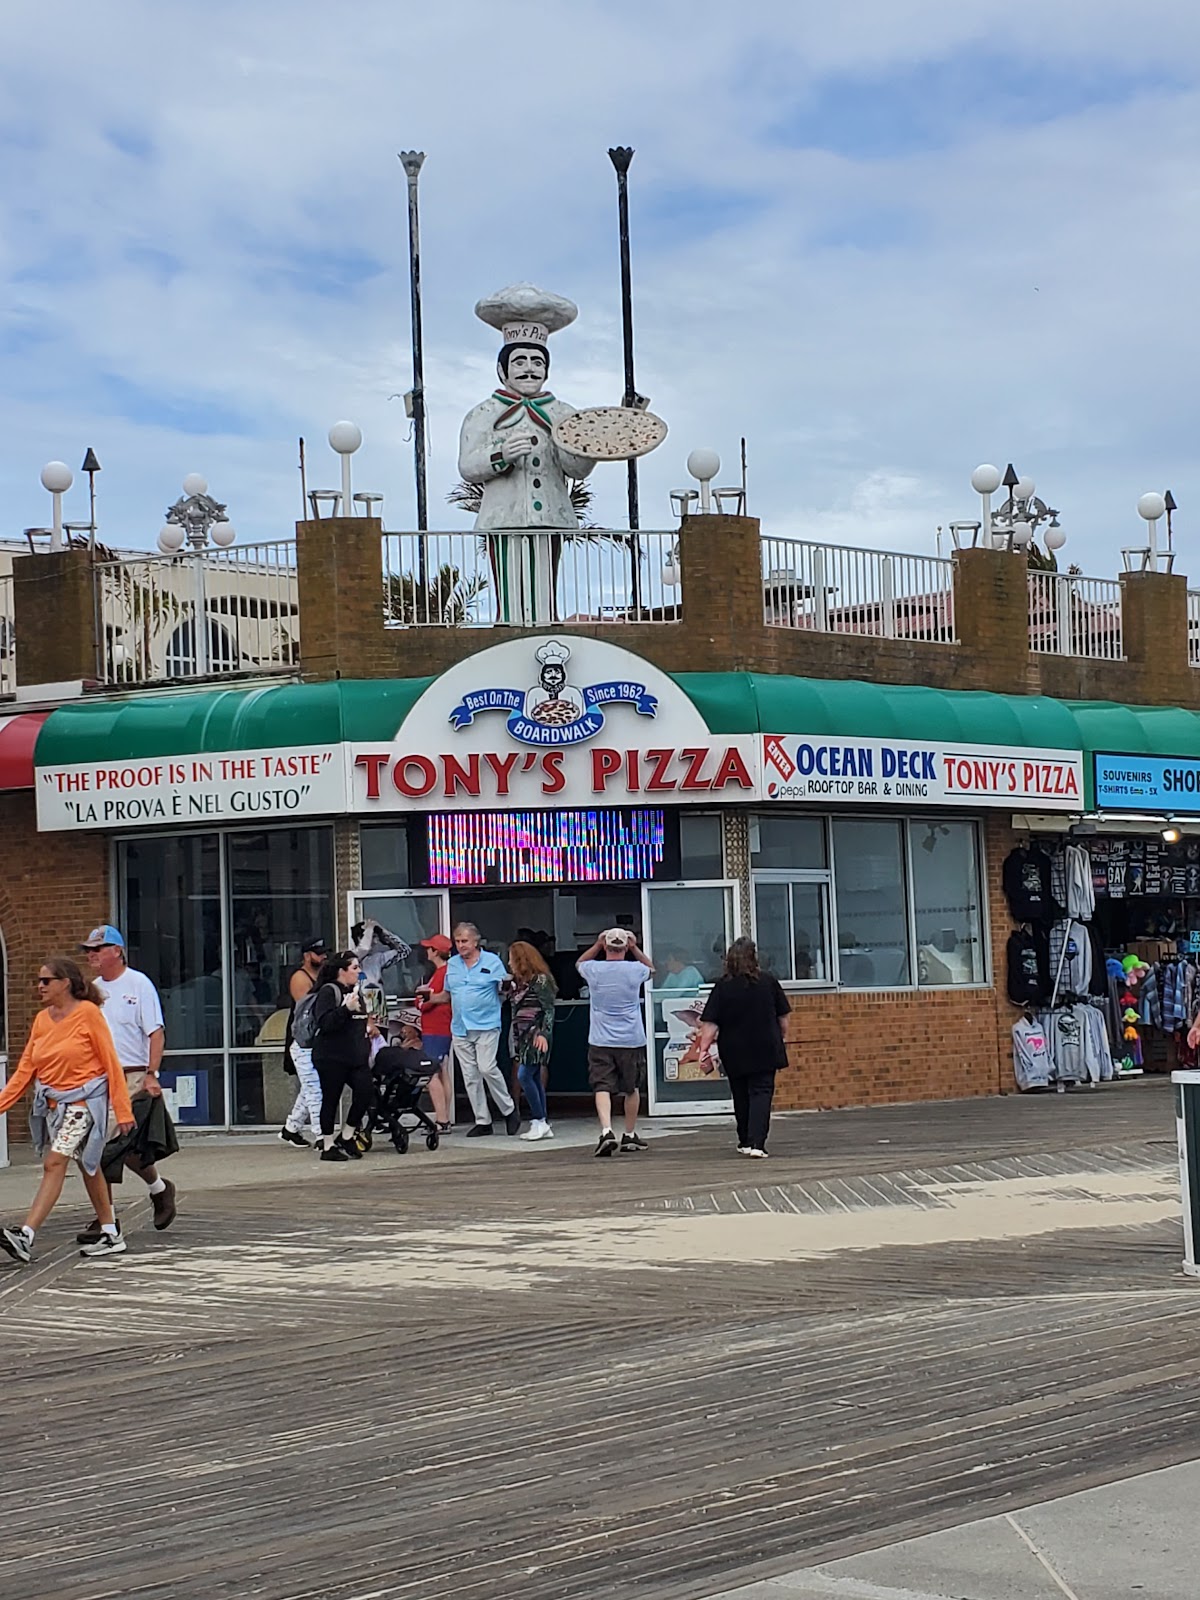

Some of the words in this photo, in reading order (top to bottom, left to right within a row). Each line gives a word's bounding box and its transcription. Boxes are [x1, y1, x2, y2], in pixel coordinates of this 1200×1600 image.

[466, 694, 488, 710] Best
[489, 692, 502, 705] On
[503, 691, 520, 708] The
[586, 686, 616, 703] Since
[617, 684, 643, 700] 1962
[513, 717, 599, 744] BOARDWALK
[767, 741, 792, 776] ENTER
[796, 743, 873, 777] OCEAN
[881, 747, 937, 780] DECK
[96, 766, 164, 791] PROOF
[169, 763, 186, 785] IS
[191, 761, 213, 783] IN
[218, 758, 256, 781] THE
[354, 751, 567, 800] TONY'S
[590, 747, 755, 793] PIZZA
[943, 758, 1016, 792] TONY'S
[1024, 763, 1078, 795] PIZZA
[1103, 770, 1152, 783] SOUVENIRS
[780, 784, 806, 799] pepsi
[808, 779, 854, 794] ROOFTOP
[858, 781, 878, 795] BAR
[884, 782, 892, 795] &
[896, 783, 928, 797] DINING
[1098, 785, 1128, 795] T-SHIRTS
[104, 797, 165, 822] PROVA
[172, 789, 182, 816] È
[188, 792, 224, 815] NEL
[1107, 866, 1127, 884] GAY
